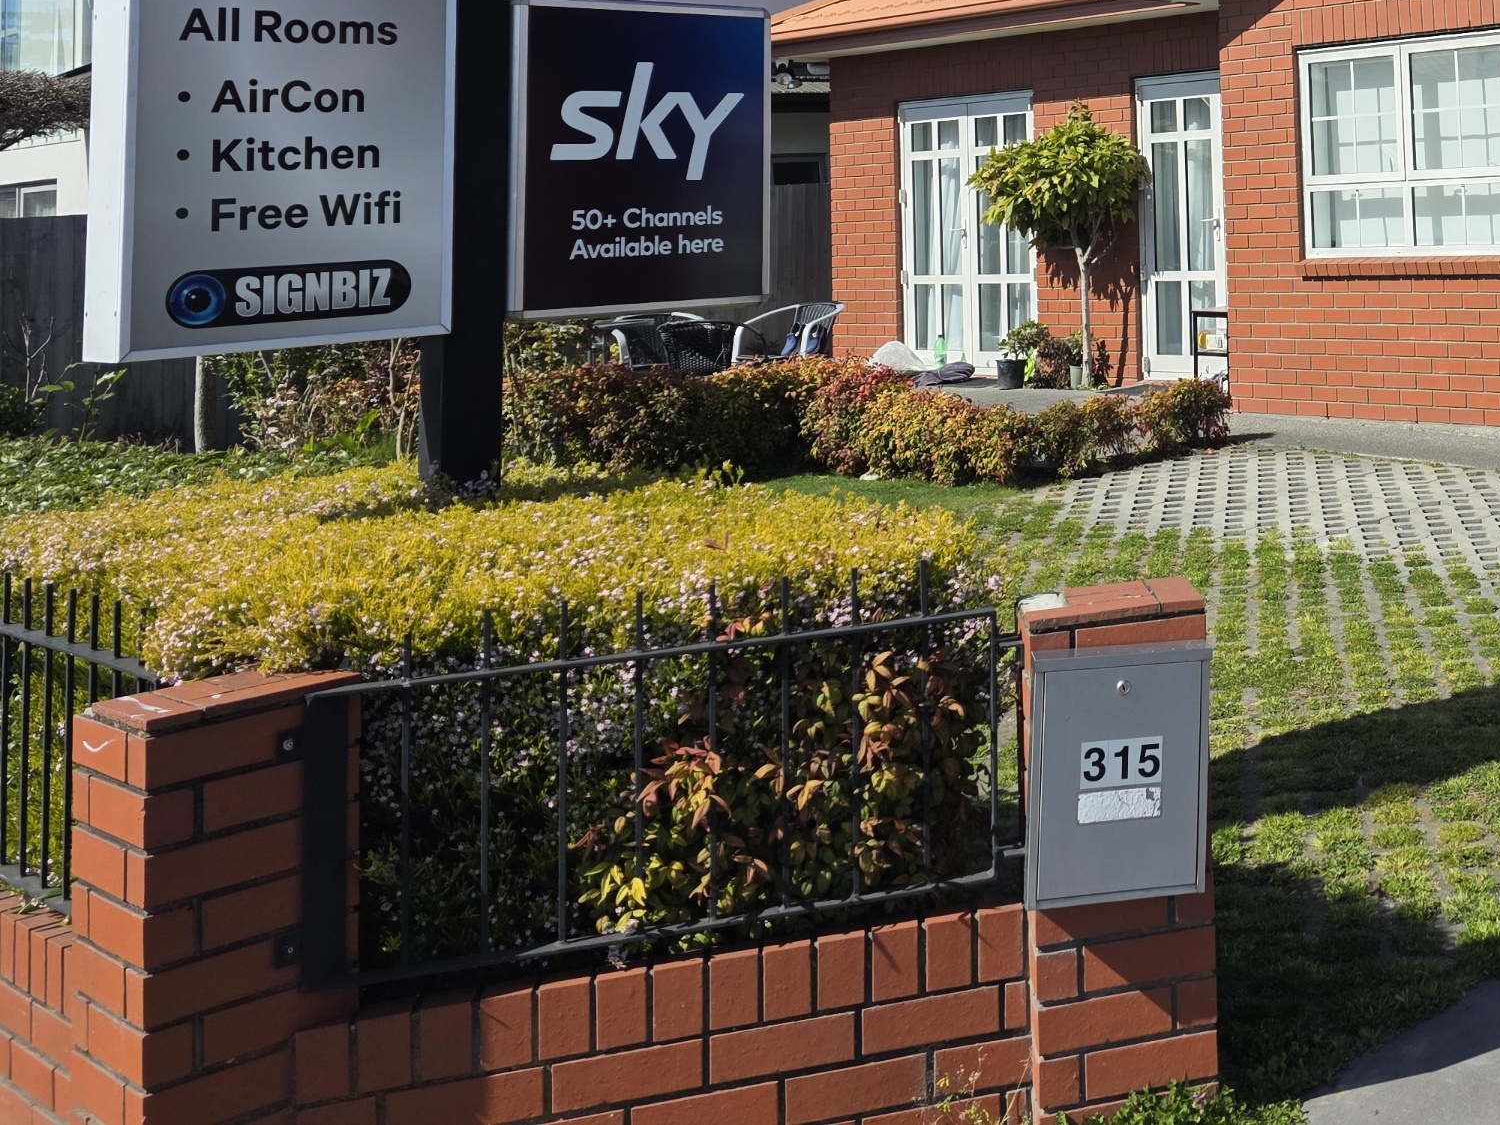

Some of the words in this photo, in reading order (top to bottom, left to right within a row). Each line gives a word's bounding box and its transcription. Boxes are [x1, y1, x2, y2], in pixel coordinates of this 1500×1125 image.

[179, 7, 240, 42] All
[254, 10, 398, 45] Rooms
[210, 79, 365, 113] AirCon
[550, 62, 745, 181] sky
[212, 136, 380, 172] Kitchen
[211, 197, 309, 232] Free
[319, 190, 402, 226] Wifi
[571, 209, 617, 230] 50+
[623, 205, 723, 228] Channels
[570, 235, 672, 259] Available
[678, 233, 724, 254] here
[235, 267, 391, 318] SIGNBIZ
[1083, 743, 1161, 782] 315
